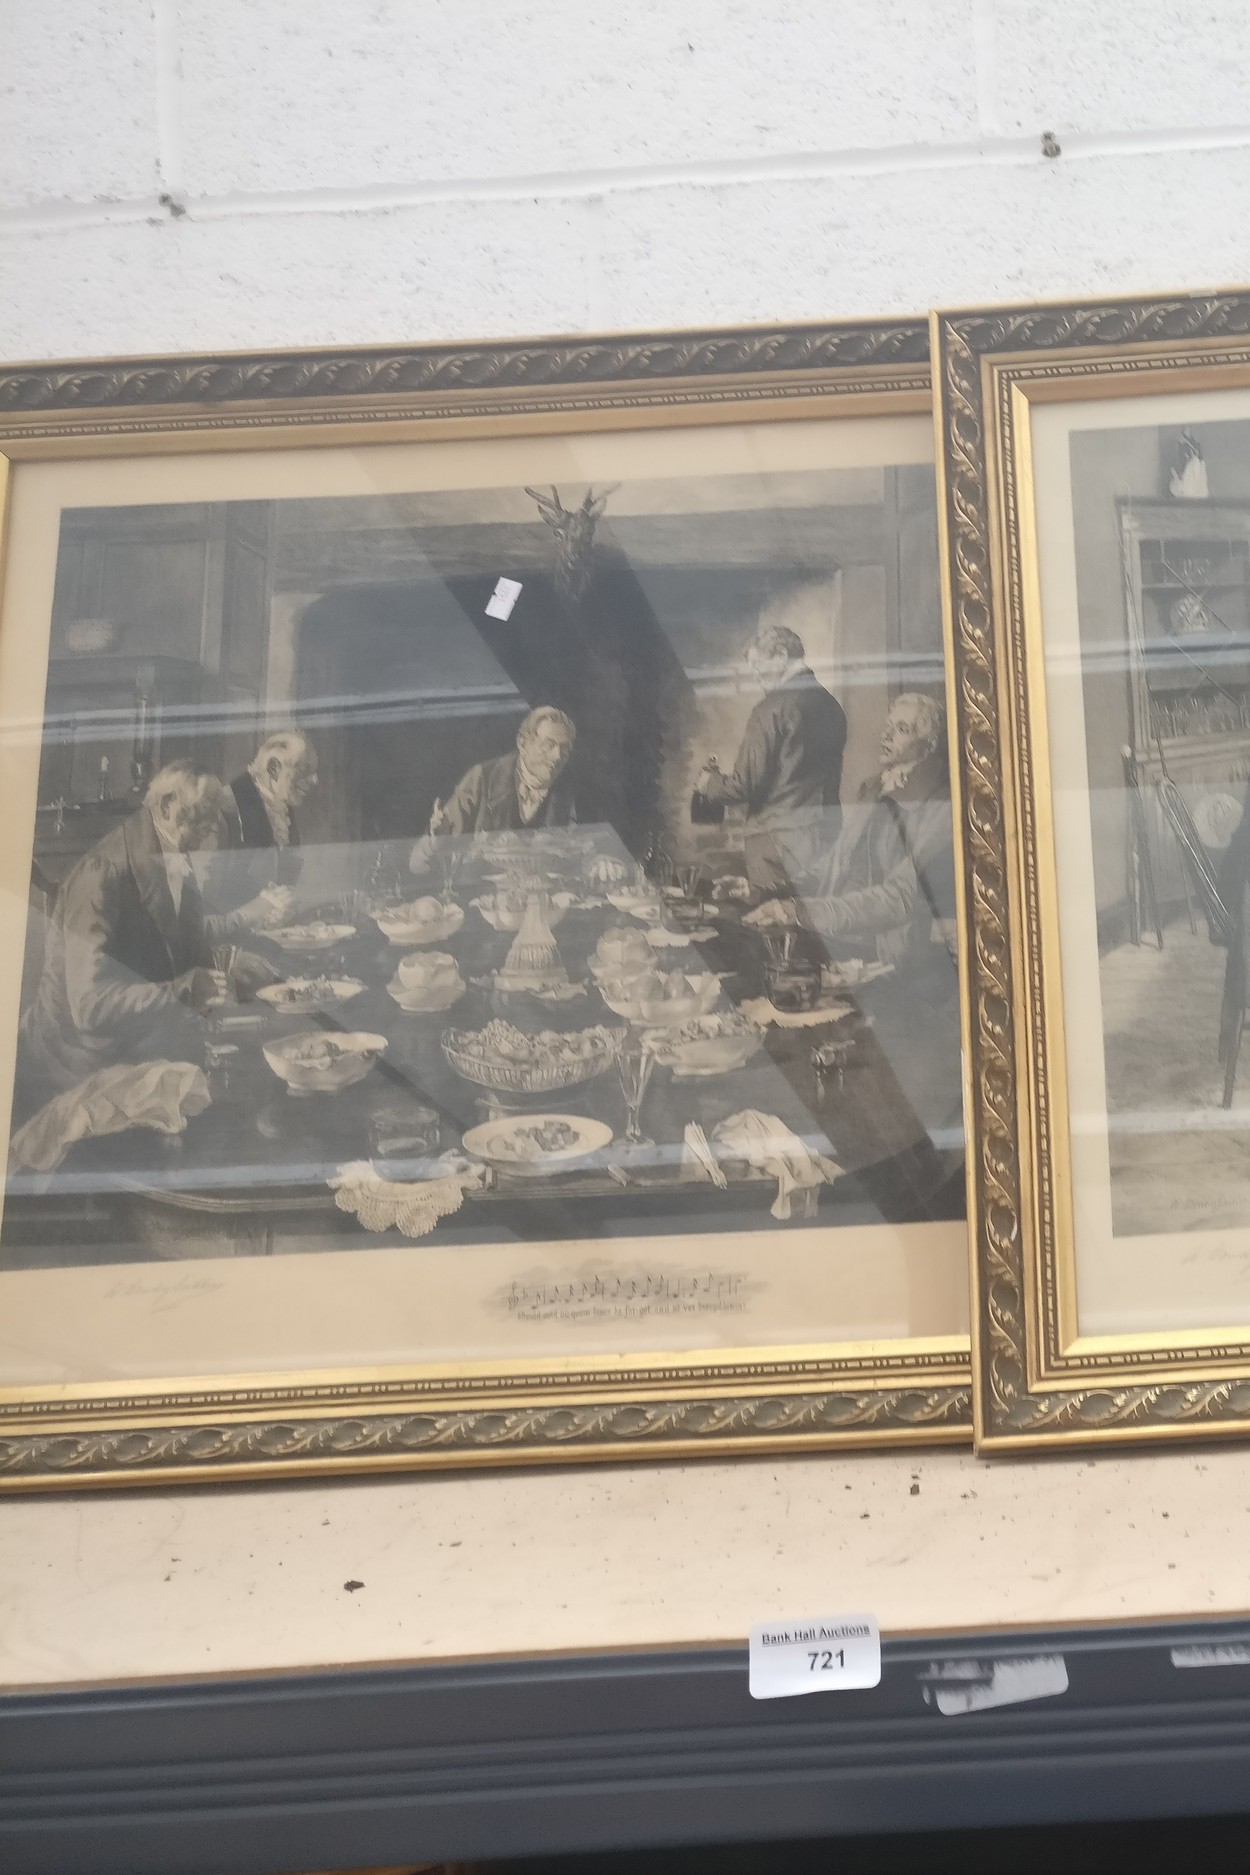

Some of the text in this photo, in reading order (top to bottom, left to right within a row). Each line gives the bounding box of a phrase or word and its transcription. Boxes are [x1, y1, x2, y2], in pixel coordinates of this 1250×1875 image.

[762, 1624, 871, 1645] Bank Hall Auctions
[807, 1648, 845, 1671] 721
